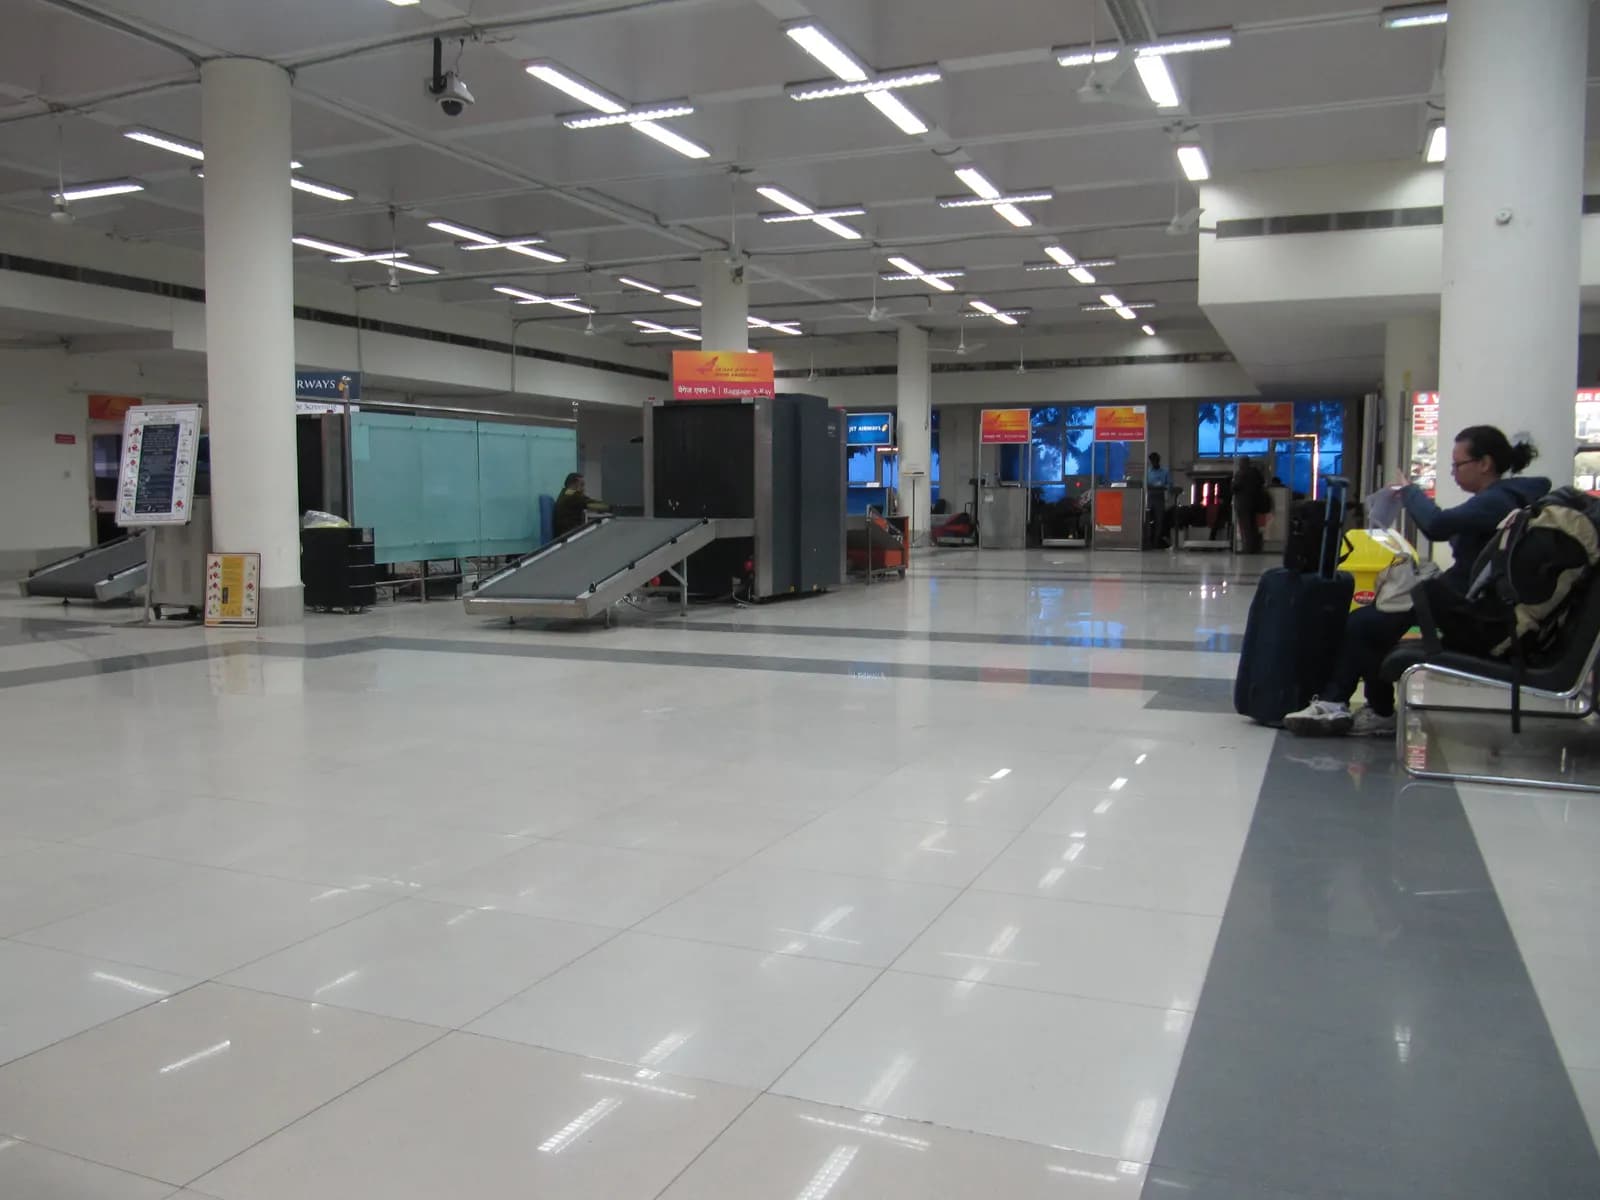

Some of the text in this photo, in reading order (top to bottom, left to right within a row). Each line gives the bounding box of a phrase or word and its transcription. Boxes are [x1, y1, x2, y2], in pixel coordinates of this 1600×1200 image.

[296, 379, 336, 389] RWAYS
[723, 386, 772, 396] Baggage X-Ray
[848, 425, 857, 433] JET
